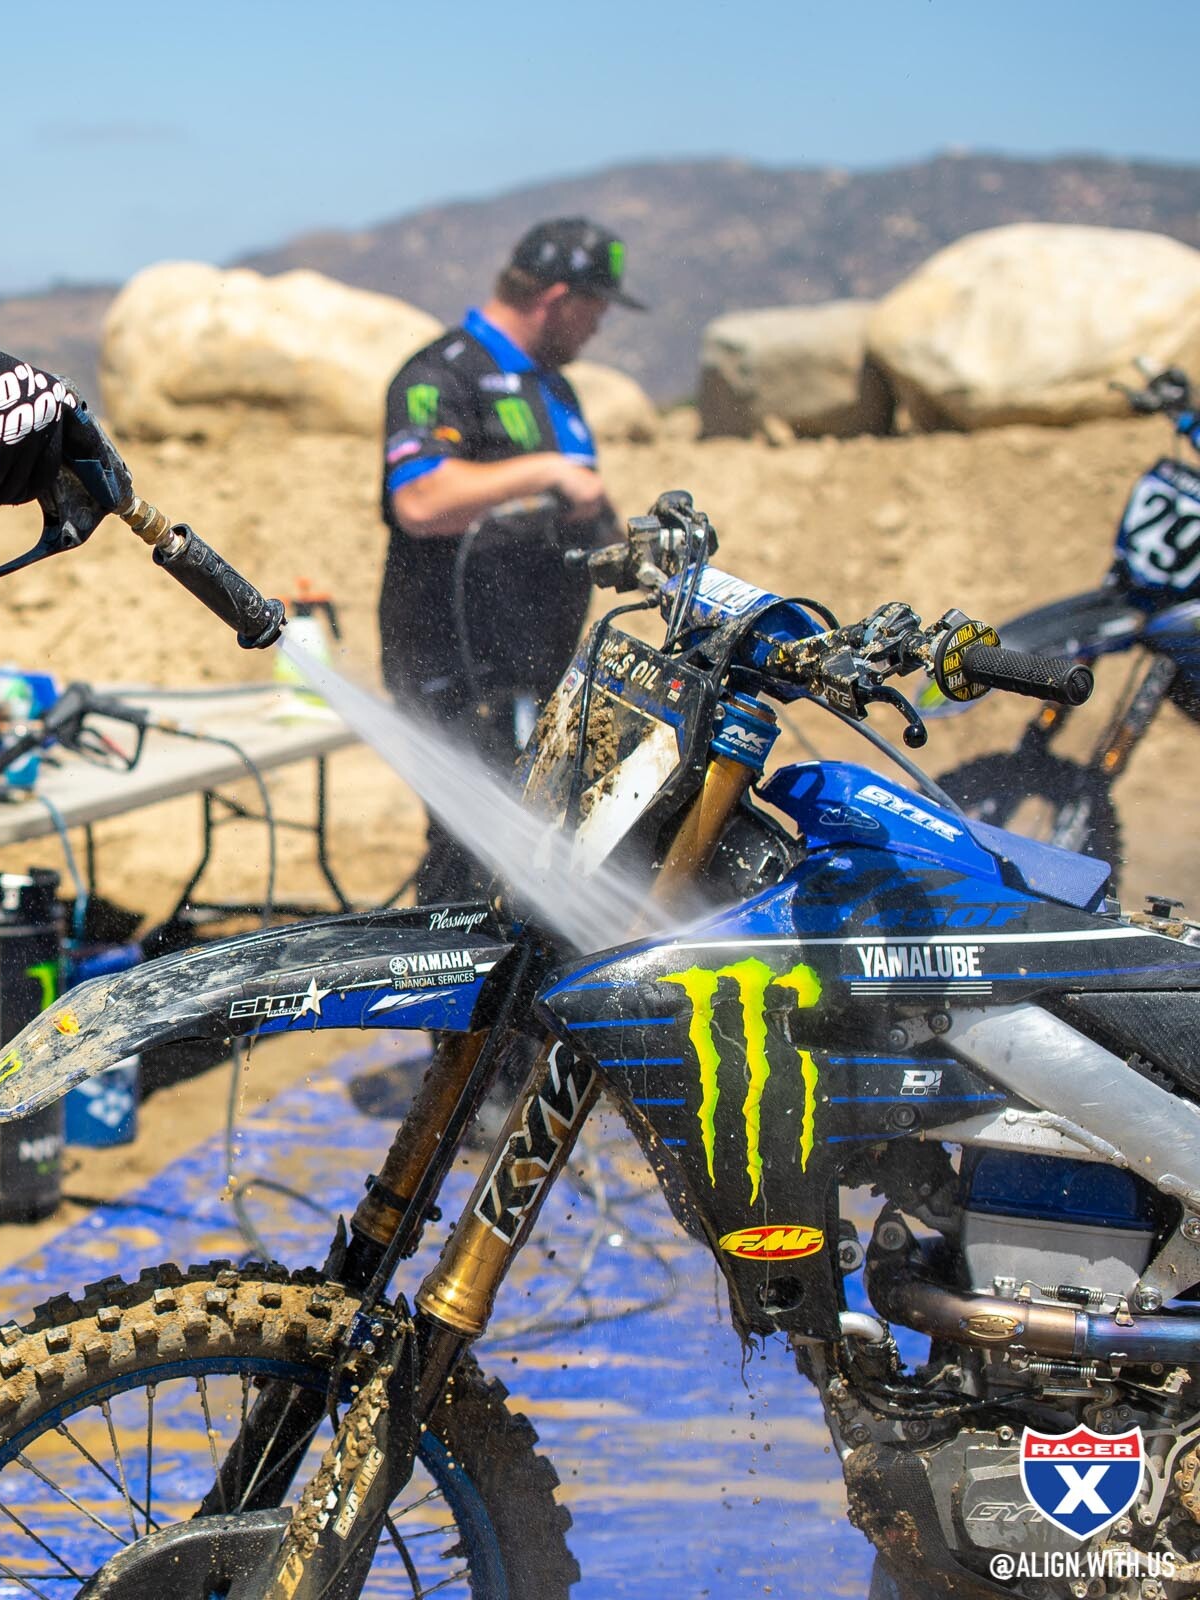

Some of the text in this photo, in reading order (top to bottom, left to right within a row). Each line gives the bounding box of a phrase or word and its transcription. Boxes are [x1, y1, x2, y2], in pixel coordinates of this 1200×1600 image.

[631, 660, 662, 691] OIL
[719, 732, 765, 756] NEKEN
[858, 784, 964, 837] GYTR
[429, 908, 488, 934] Plessinger
[408, 950, 474, 973] YAMAHA
[394, 972, 475, 990] FINANCIAL SERVICES
[720, 1229, 824, 1252] FMF
[333, 1446, 385, 1540] BRAKING
